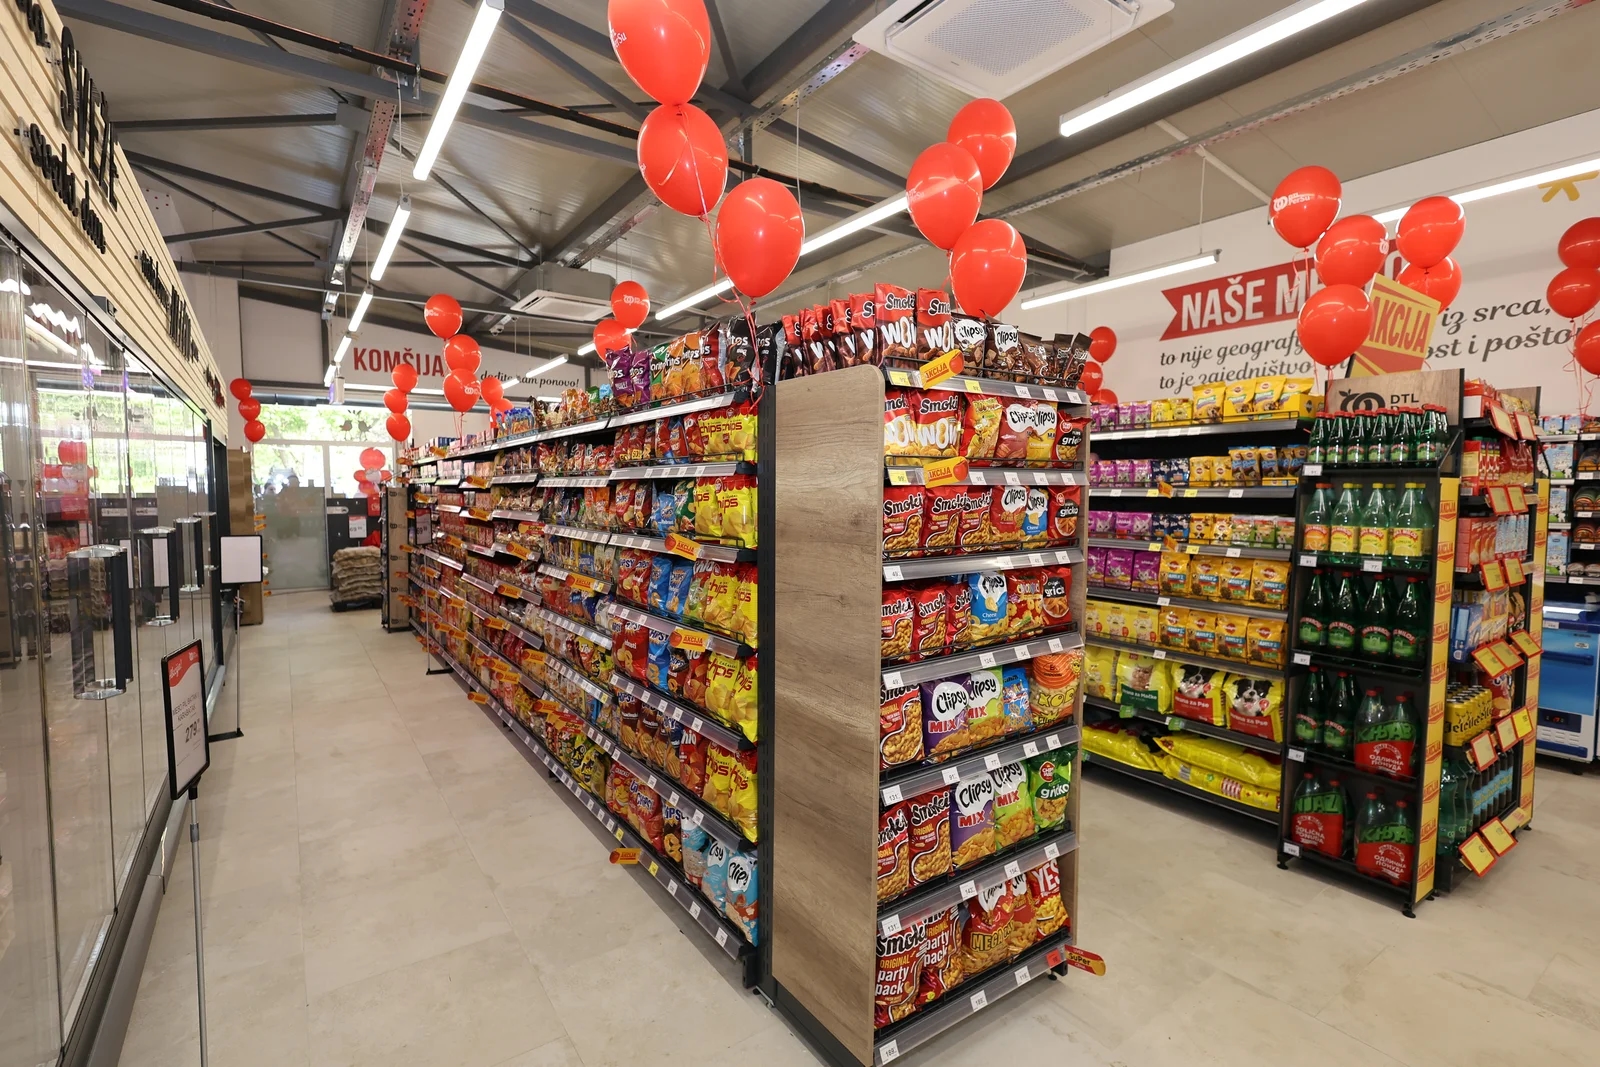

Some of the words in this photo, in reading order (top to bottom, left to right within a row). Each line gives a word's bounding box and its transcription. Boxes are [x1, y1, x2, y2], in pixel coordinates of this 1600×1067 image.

[1181, 275, 1266, 332] NAŠE
[1160, 351, 1177, 366] to
[1180, 344, 1212, 369] nije
[1473, 297, 1551, 324] srca,
[1369, 296, 1431, 354] AKCIJA
[1159, 376, 1178, 389] to
[1174, 373, 1196, 394] je
[1468, 335, 1477, 355] i
[920, 395, 959, 414] Smoki
[1390, 393, 1420, 404] DTL
[883, 493, 923, 516] Smoki
[1004, 489, 1026, 505] Clipsy
[677, 542, 695, 555] AKCIJA
[936, 690, 968, 714] Clipsy
[928, 720, 957, 733] MIX
[682, 730, 697, 745] hio
[960, 779, 992, 808] Clipsy
[995, 790, 1020, 808] MIX
[1040, 782, 1070, 799] gricko
[911, 791, 950, 826] Smoki
[958, 810, 985, 828] MIX
[972, 931, 1003, 951] MEGA
[880, 954, 910, 969] ORIGINAL
[923, 945, 948, 968] pack
[877, 966, 910, 983] party
[875, 981, 905, 996] pack
